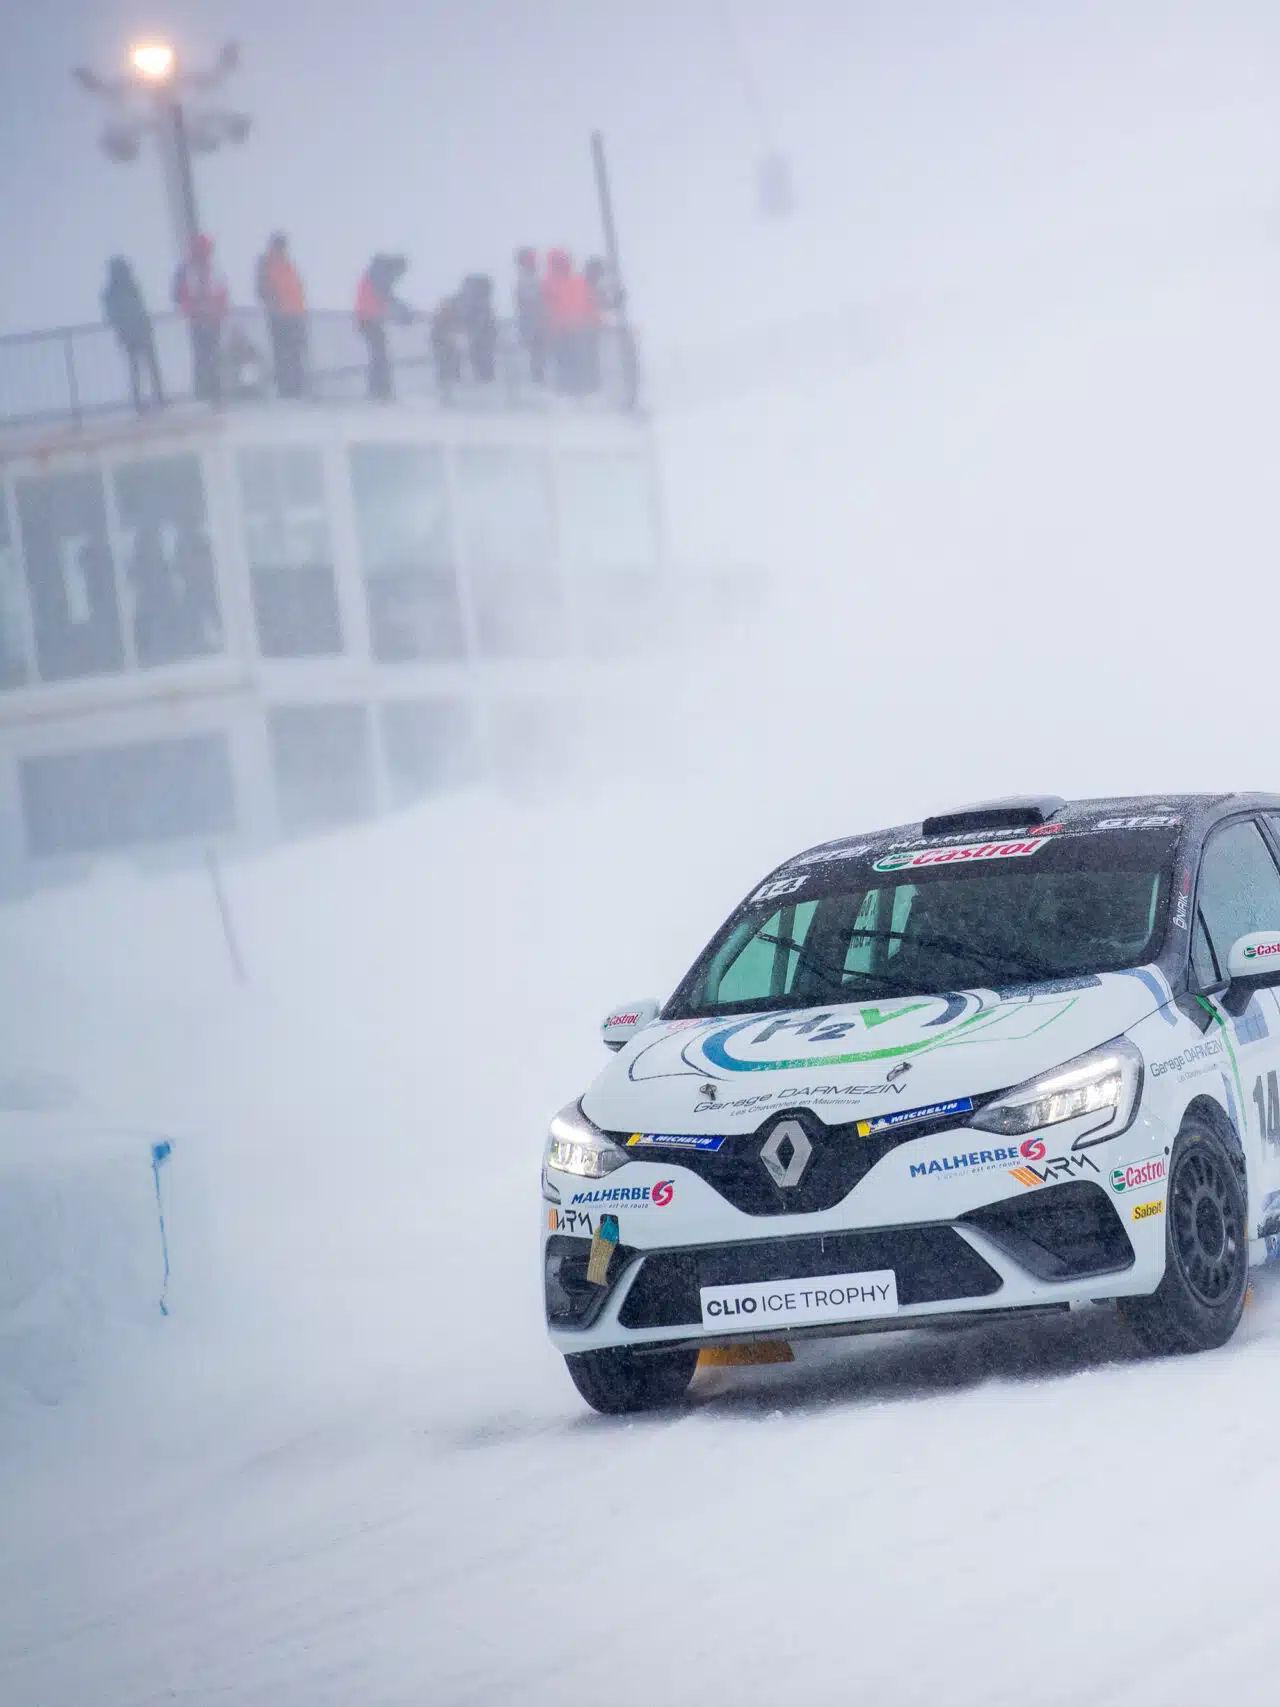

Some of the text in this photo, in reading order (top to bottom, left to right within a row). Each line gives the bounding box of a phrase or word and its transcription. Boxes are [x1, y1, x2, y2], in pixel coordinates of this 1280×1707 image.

[913, 839, 1041, 864] Castrol
[608, 1013, 640, 1026] Castrol
[1150, 1055, 1186, 1077] Garage
[694, 1083, 906, 1113] Garage DARMEZIN
[891, 1101, 957, 1123] MICHELIN
[655, 1135, 713, 1146] MICHELIN
[909, 1146, 1019, 1178] MALHERBE
[1125, 1157, 1166, 1188] Castrol
[571, 1187, 651, 1205] MALHERBE
[706, 1283, 890, 1317] CLIO ICE TROPHY
